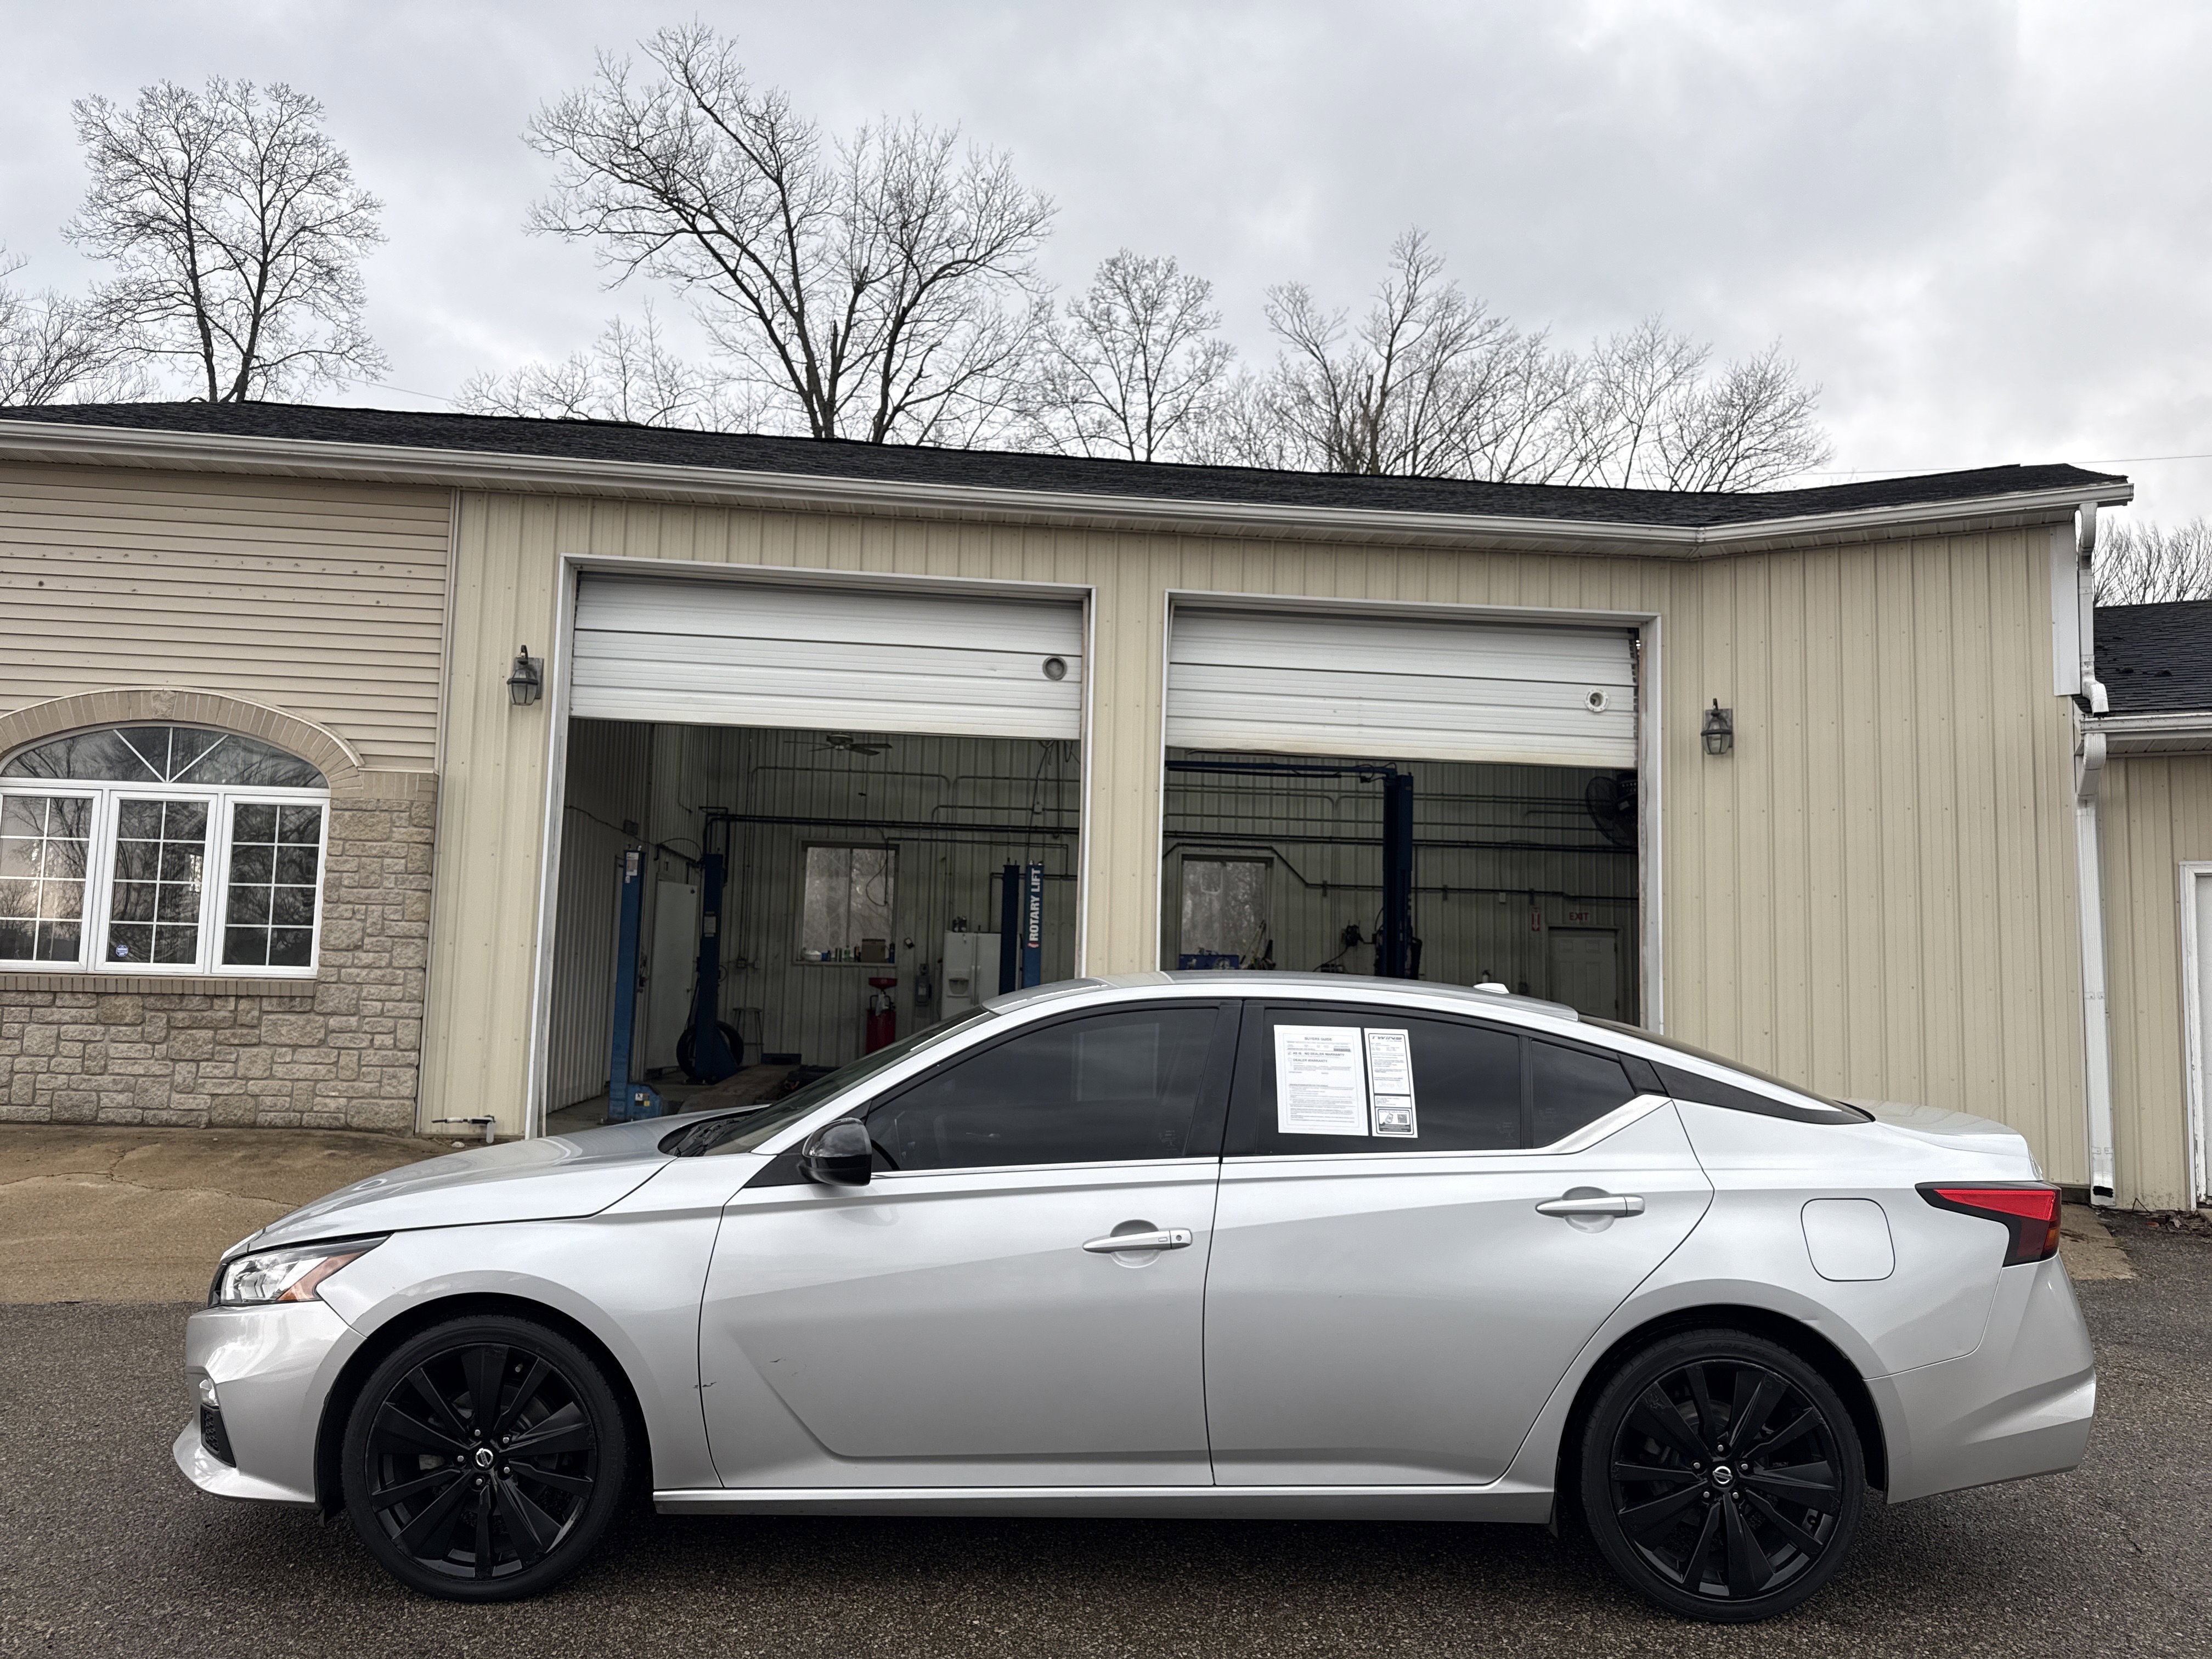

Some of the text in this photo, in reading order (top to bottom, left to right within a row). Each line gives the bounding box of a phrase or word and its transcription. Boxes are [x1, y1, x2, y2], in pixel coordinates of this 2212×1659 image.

[1029, 868, 1041, 941] ROTARY LIFT
[1568, 912, 1589, 921] EXIT
